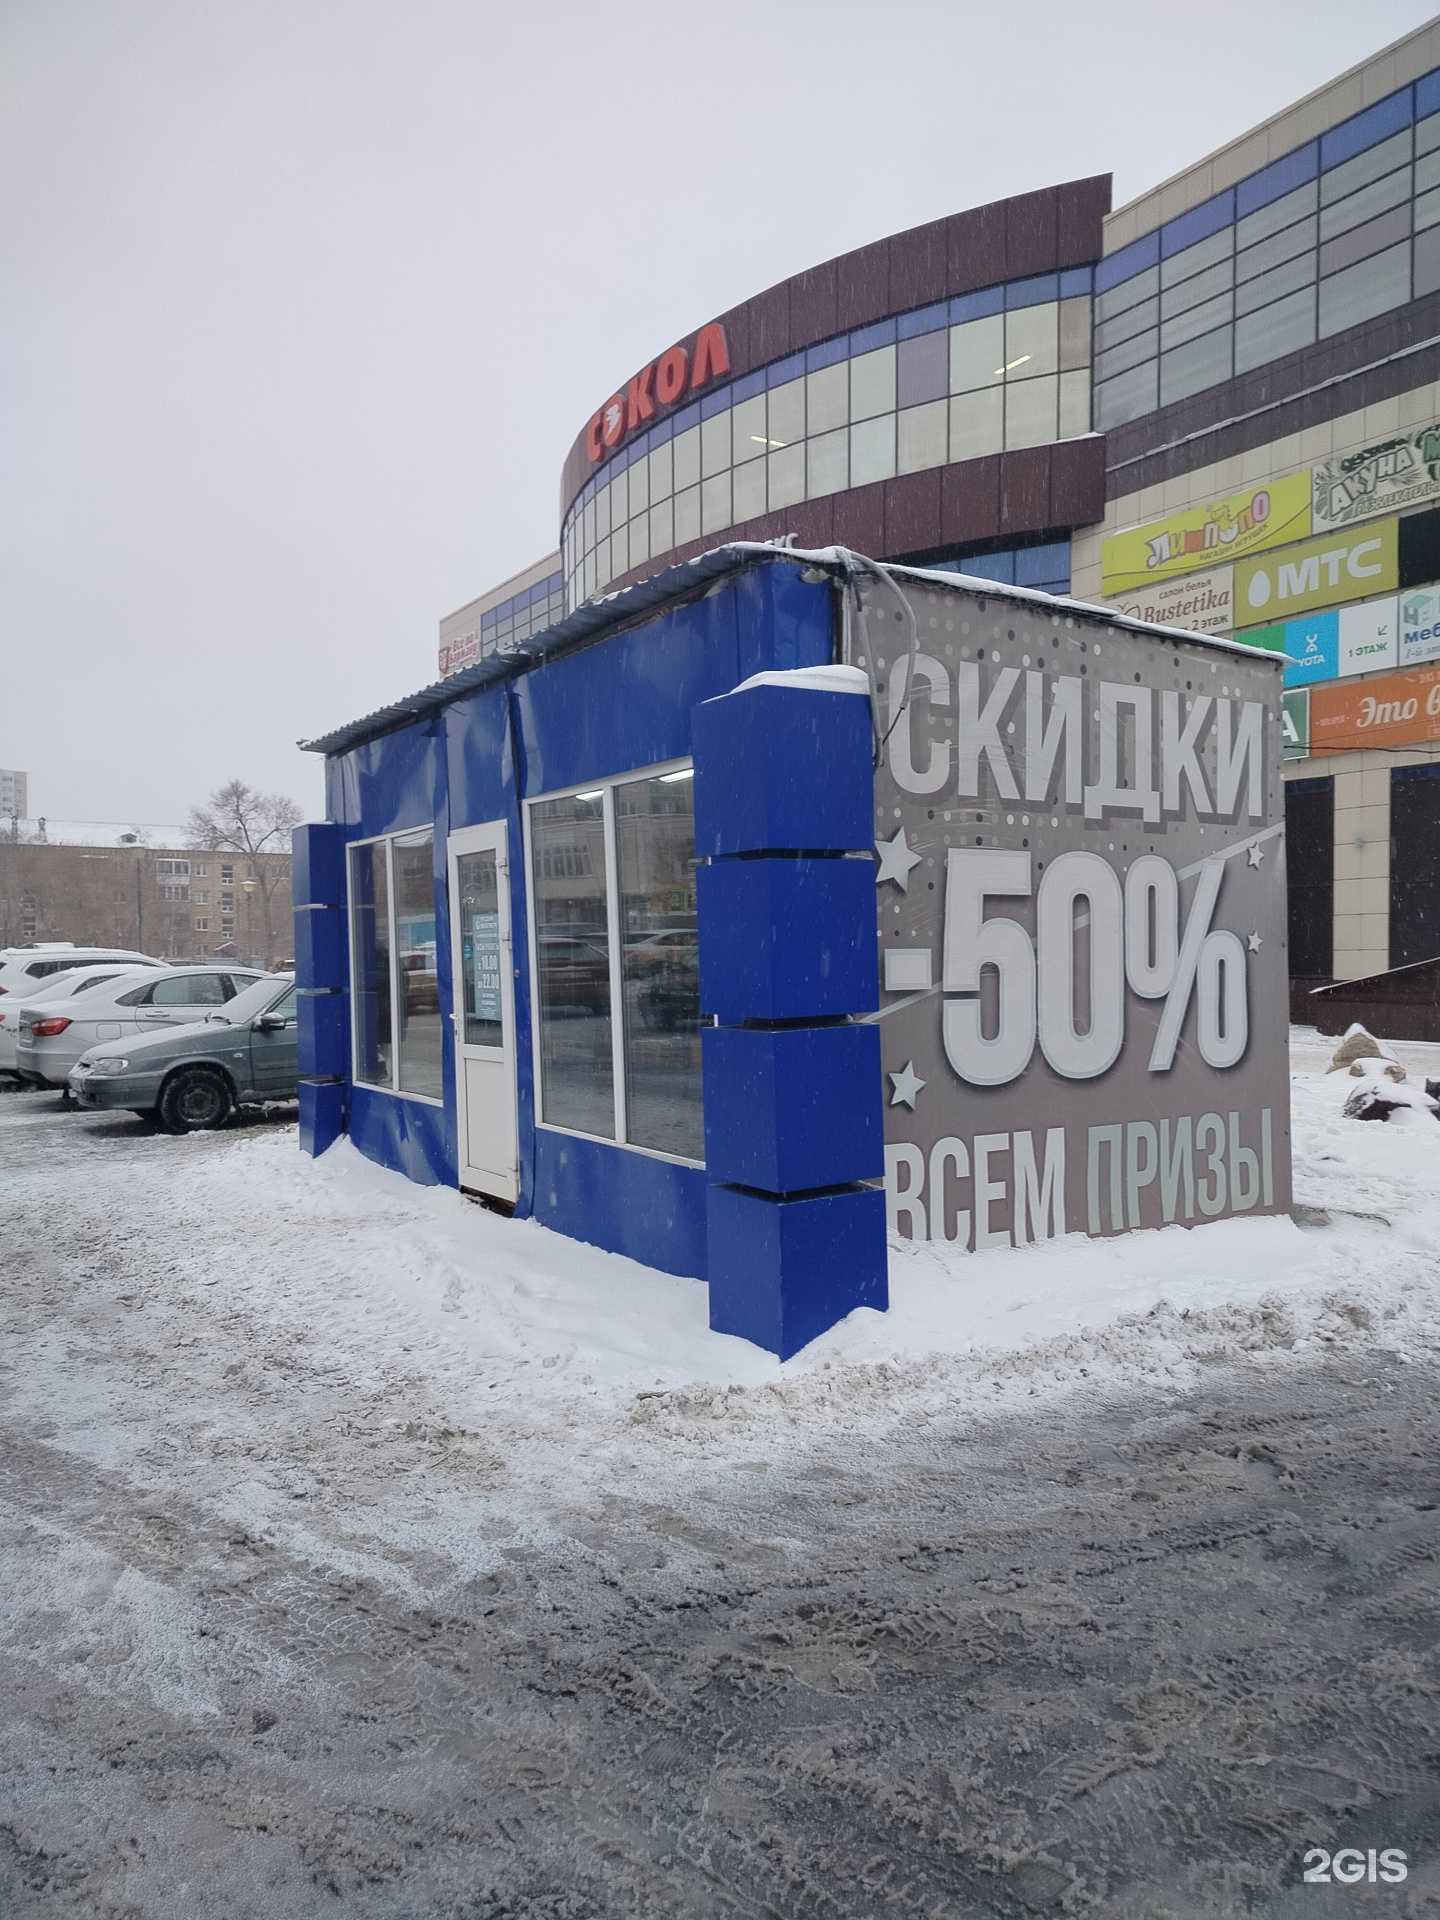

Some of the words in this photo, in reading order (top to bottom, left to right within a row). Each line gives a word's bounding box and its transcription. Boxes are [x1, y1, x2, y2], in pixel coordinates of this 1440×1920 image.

[587, 322, 730, 463] СОКОЛ
[1277, 538, 1382, 599] МТС
[1144, 590, 1230, 624] Bustetika
[1159, 587, 1184, 600] салон
[1191, 619, 1199, 631] 2
[1201, 614, 1228, 629] этаж
[1354, 642, 1389, 657] ЭТАЖ
[1356, 696, 1419, 728] Это
[888, 653, 1264, 824] СКИДКИ
[884, 847, 1249, 1087] -50%
[883, 1127, 1067, 1252] ВСЕМ
[1086, 1108, 1273, 1235] ПРИЗЫ
